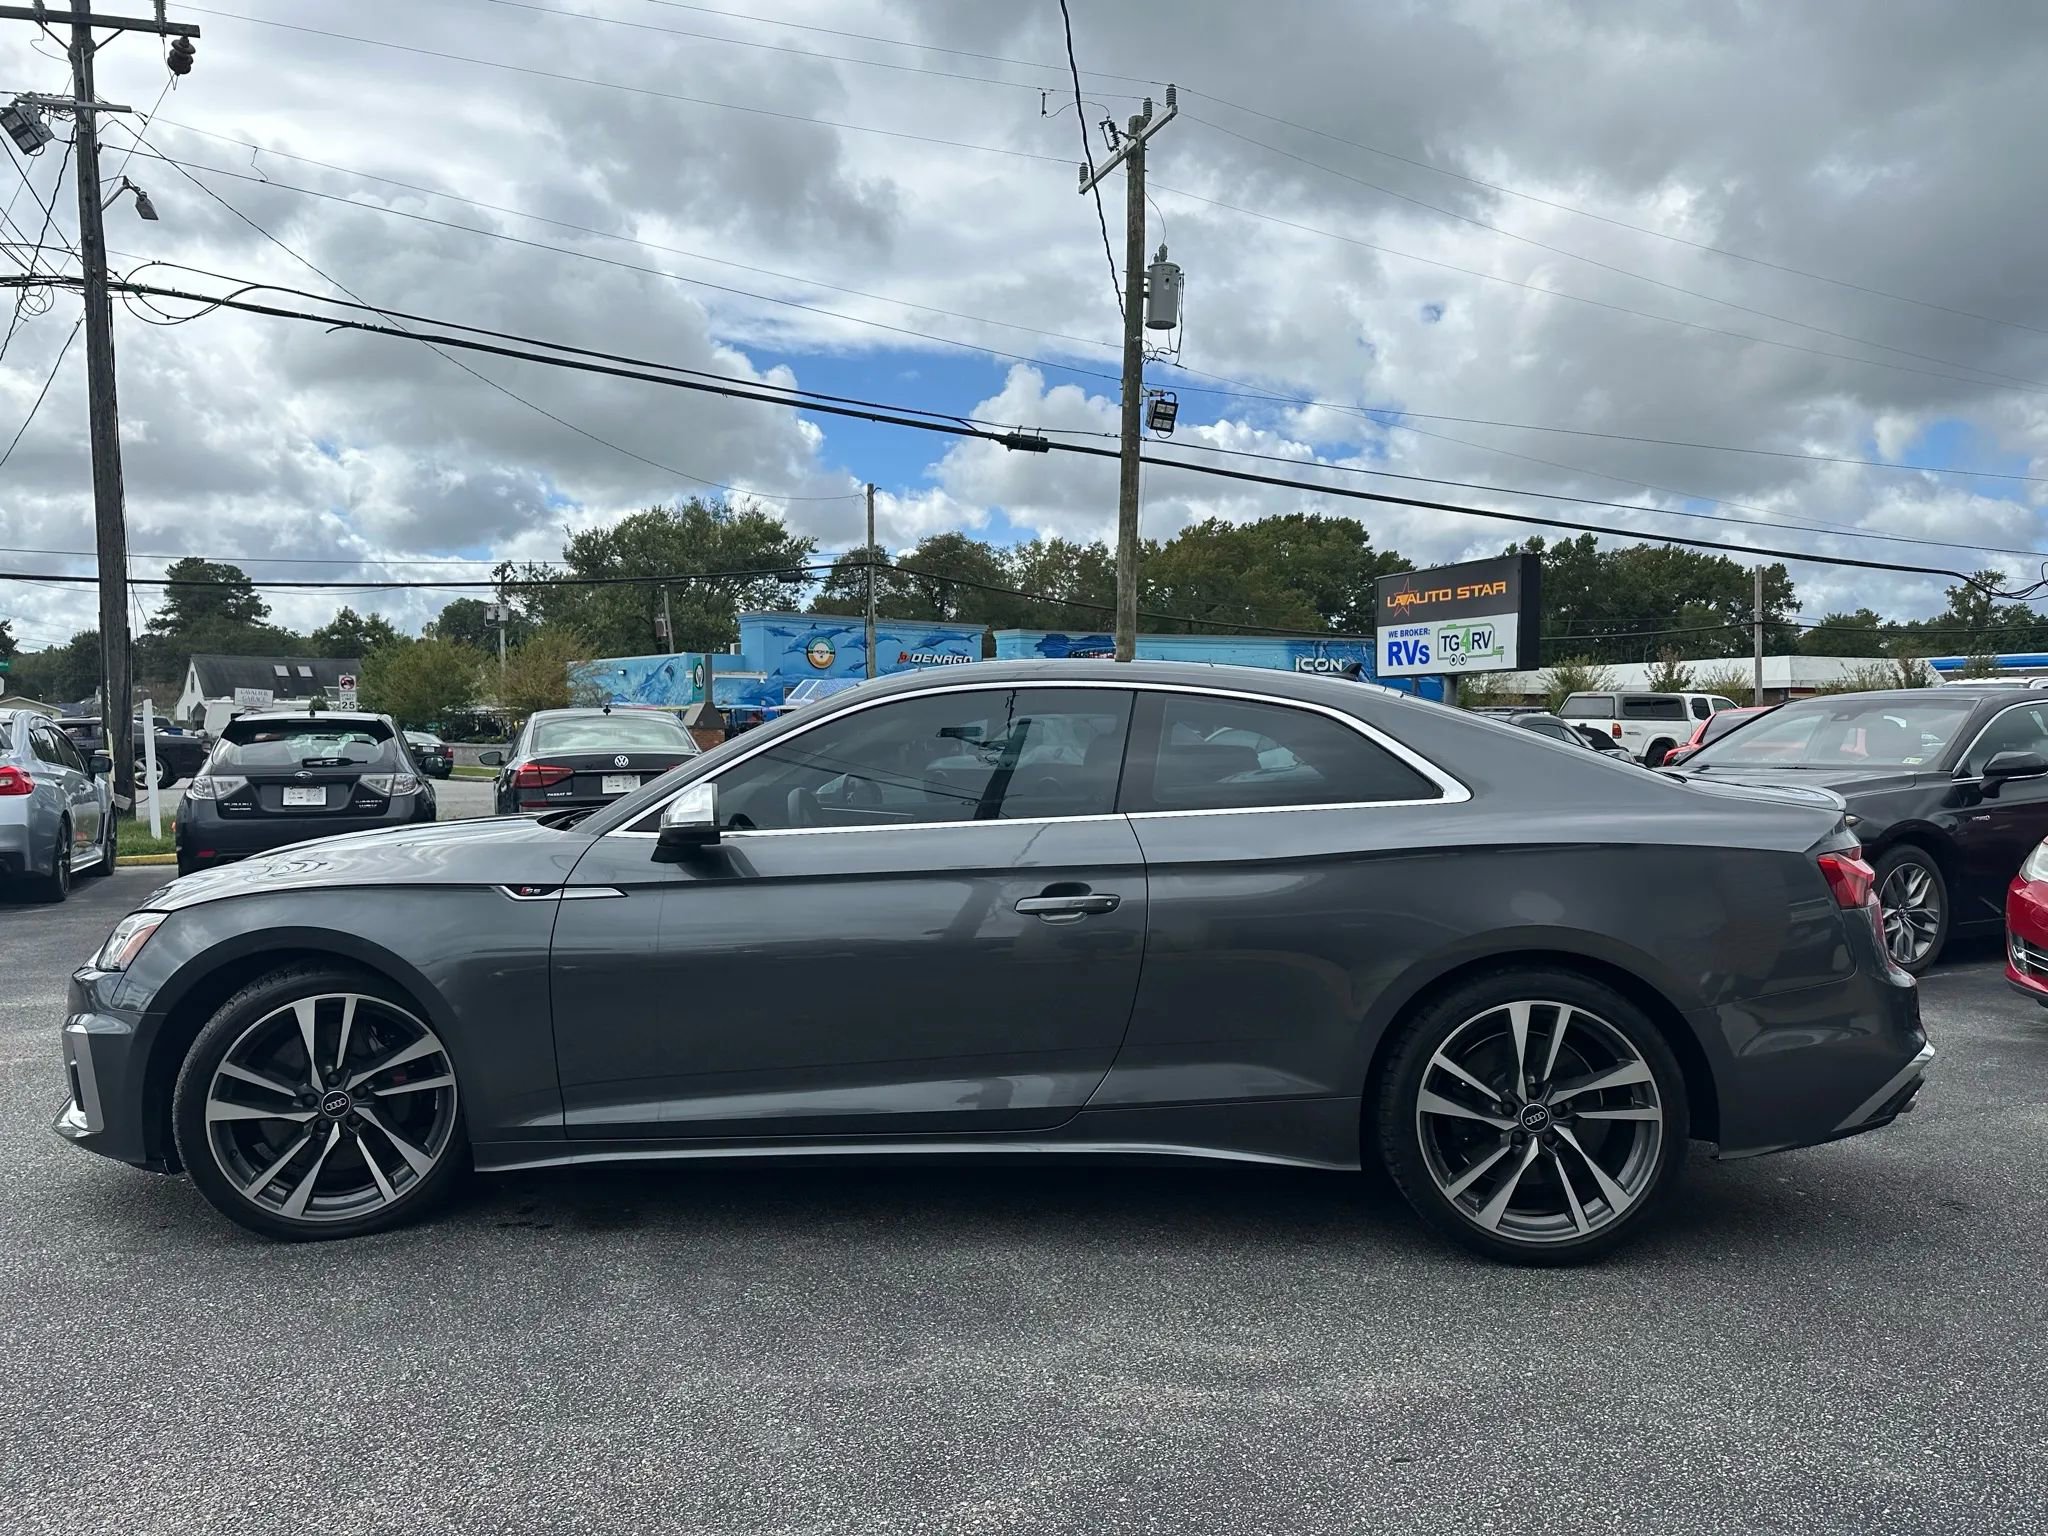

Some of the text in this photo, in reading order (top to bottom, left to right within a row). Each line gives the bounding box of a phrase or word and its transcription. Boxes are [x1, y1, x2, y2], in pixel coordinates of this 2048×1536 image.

[1387, 580, 1507, 608] LA AUTO STAR
[1388, 627, 1431, 638] WE BROKER:
[1440, 628, 1493, 653] TG4RV
[910, 653, 974, 665] DENAGO
[1387, 639, 1431, 667] RVs
[1295, 657, 1343, 672] ICON
[341, 701, 355, 710] 25
